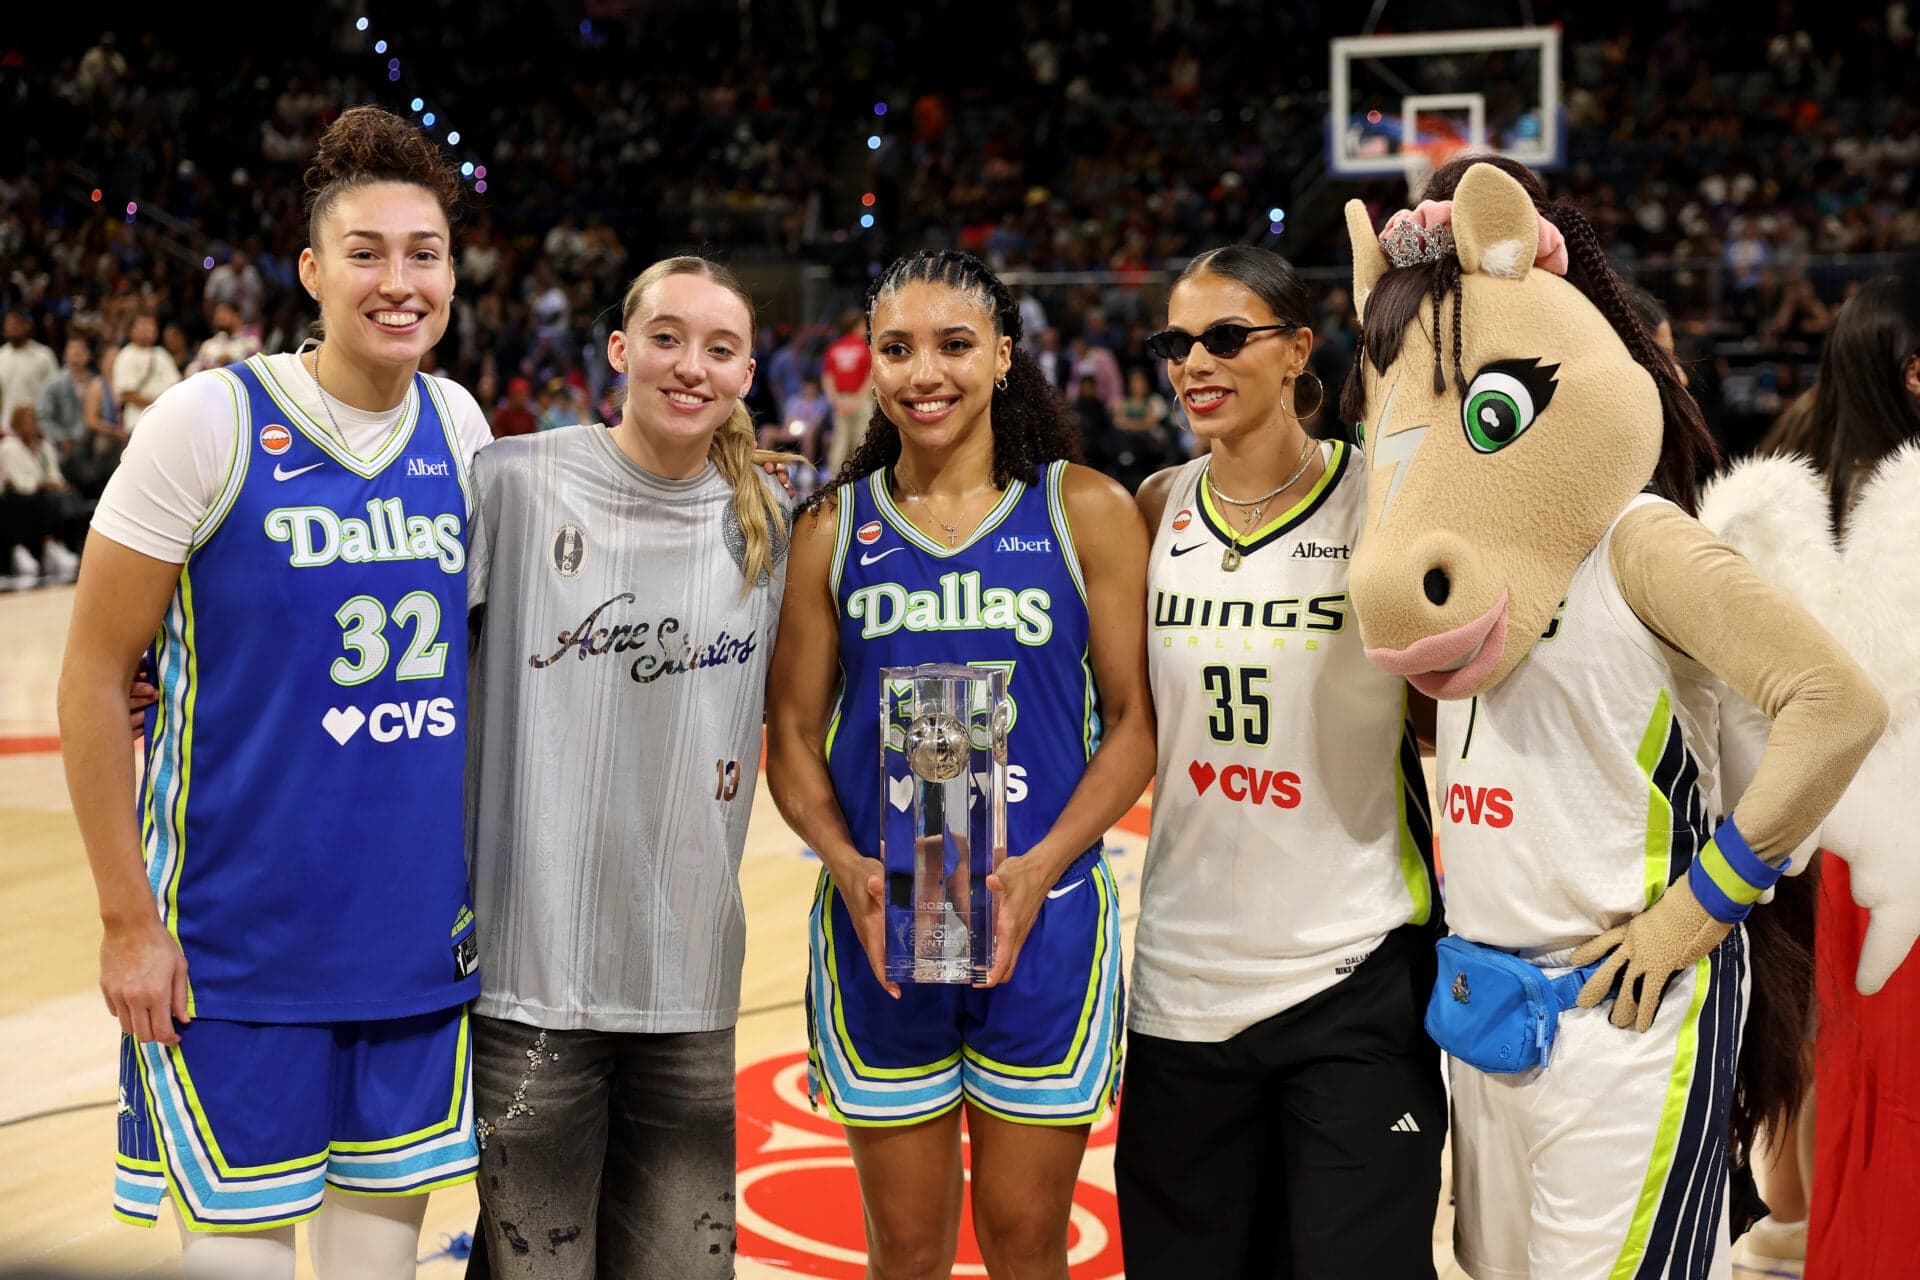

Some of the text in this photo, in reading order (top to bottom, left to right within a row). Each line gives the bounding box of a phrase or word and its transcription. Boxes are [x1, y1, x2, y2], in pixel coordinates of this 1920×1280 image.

[407, 458, 449, 476] Albert
[264, 497, 465, 574] Dallas
[995, 536, 1052, 553] Albert
[1291, 542, 1350, 560] Albert
[529, 592, 650, 669] Acne
[847, 570, 1053, 646] Dallas
[330, 590, 449, 687] 32
[1163, 636, 1319, 651] DALLAS
[368, 697, 456, 743] CVS
[1200, 661, 1273, 749] 35
[715, 759, 741, 801] 13
[1219, 764, 1302, 809] CVS
[1449, 783, 1514, 829] CVS
